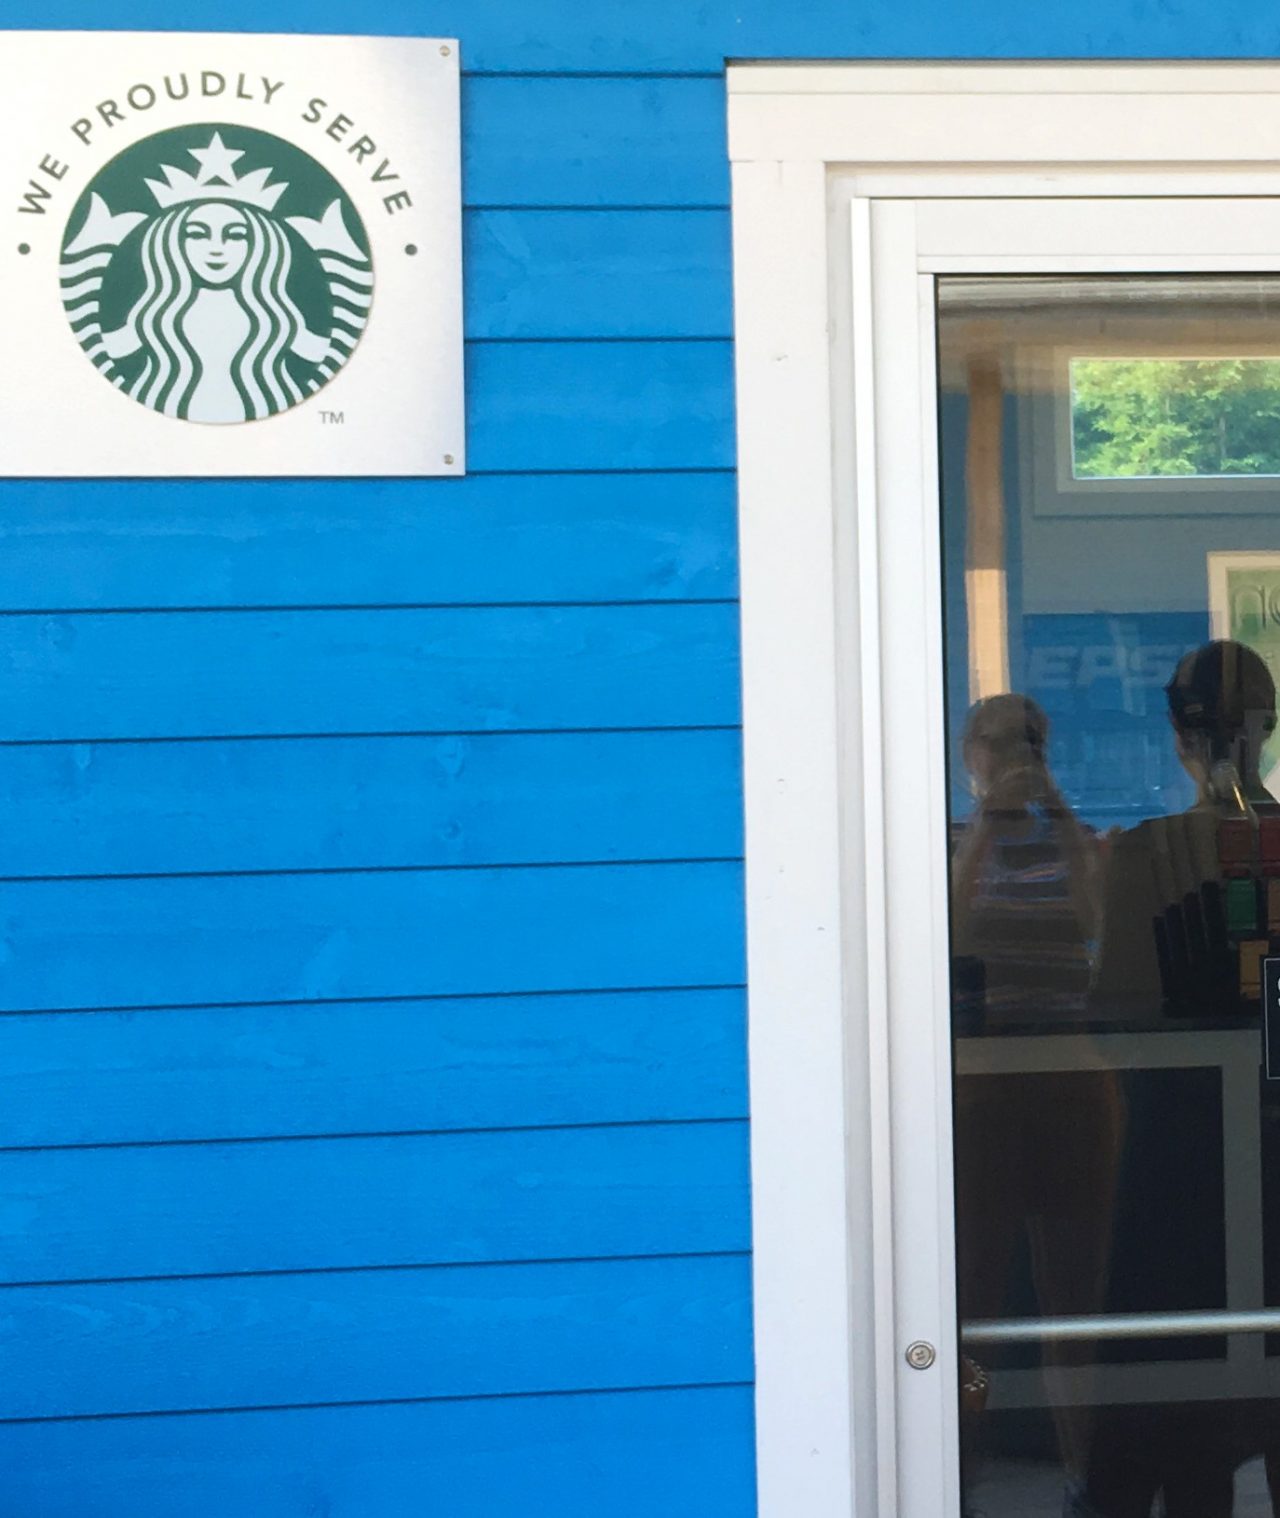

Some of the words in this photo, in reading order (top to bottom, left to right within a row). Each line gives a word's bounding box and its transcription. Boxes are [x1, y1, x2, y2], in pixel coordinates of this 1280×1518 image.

[18, 153, 70, 217] WE
[71, 70, 285, 145] PROUDLY
[301, 97, 414, 215] SERVE
[318, 410, 345, 425] TM
